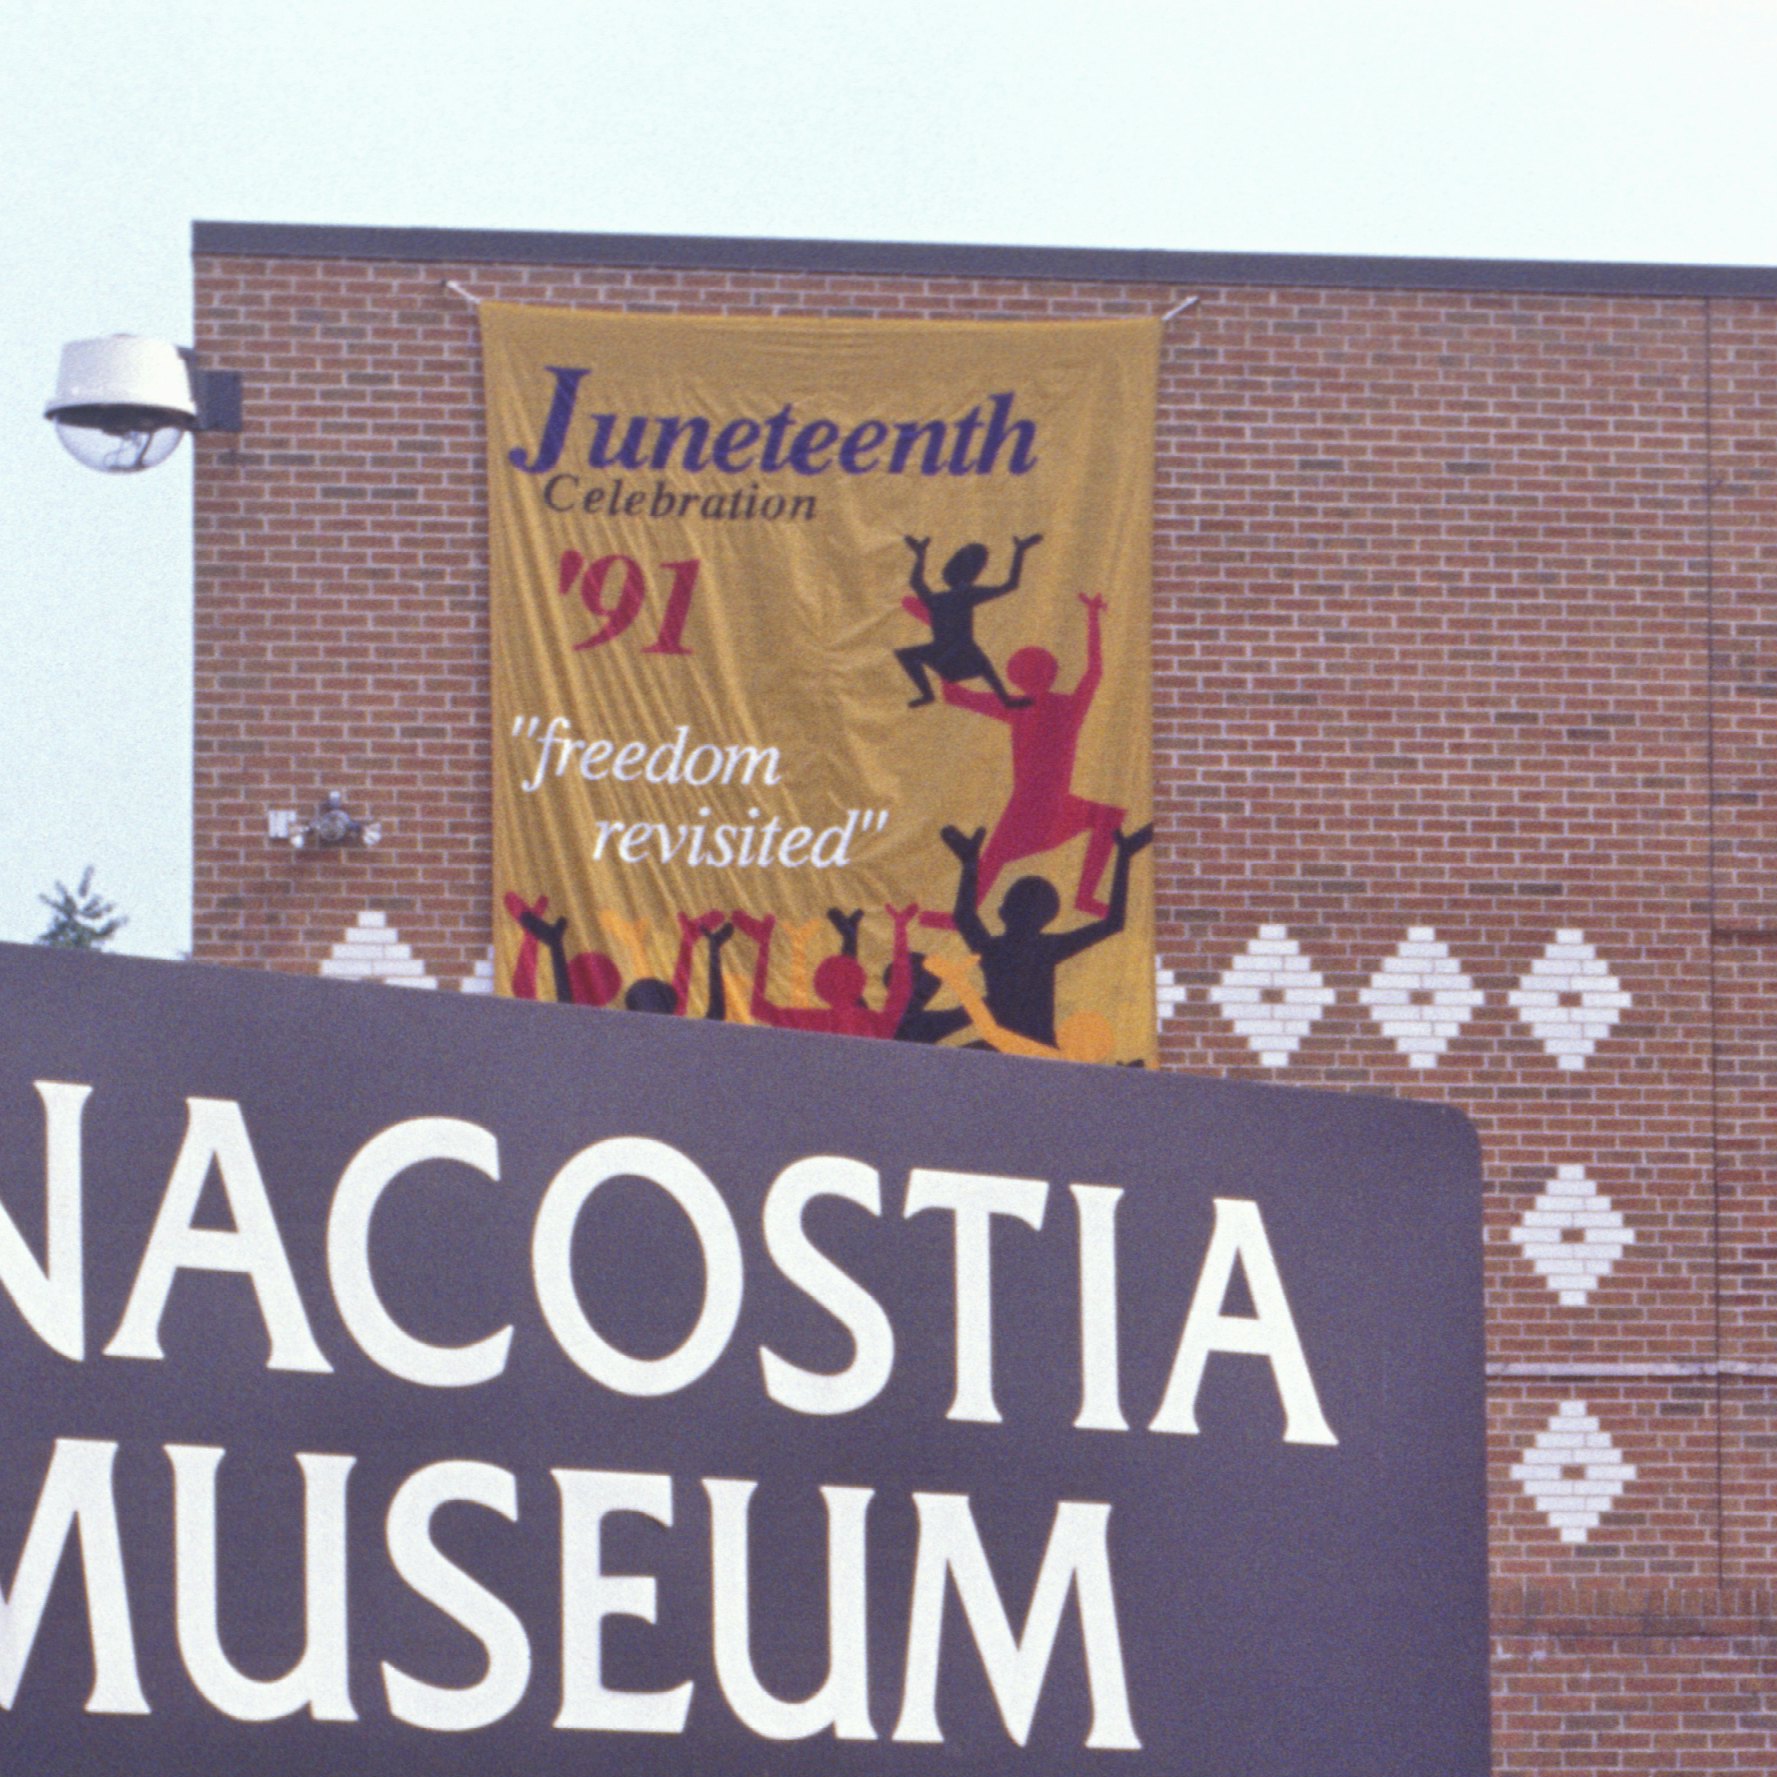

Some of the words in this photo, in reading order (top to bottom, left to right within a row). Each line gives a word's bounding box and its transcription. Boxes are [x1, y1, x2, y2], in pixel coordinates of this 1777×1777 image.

[508, 364, 1038, 477] Juneteenth
[543, 473, 818, 521] Celebration
[558, 549, 701, 656] '91
[511, 715, 783, 792] "freedom
[592, 807, 889, 869] revisited"
[0, 1437, 1142, 1750] MUSEUM
